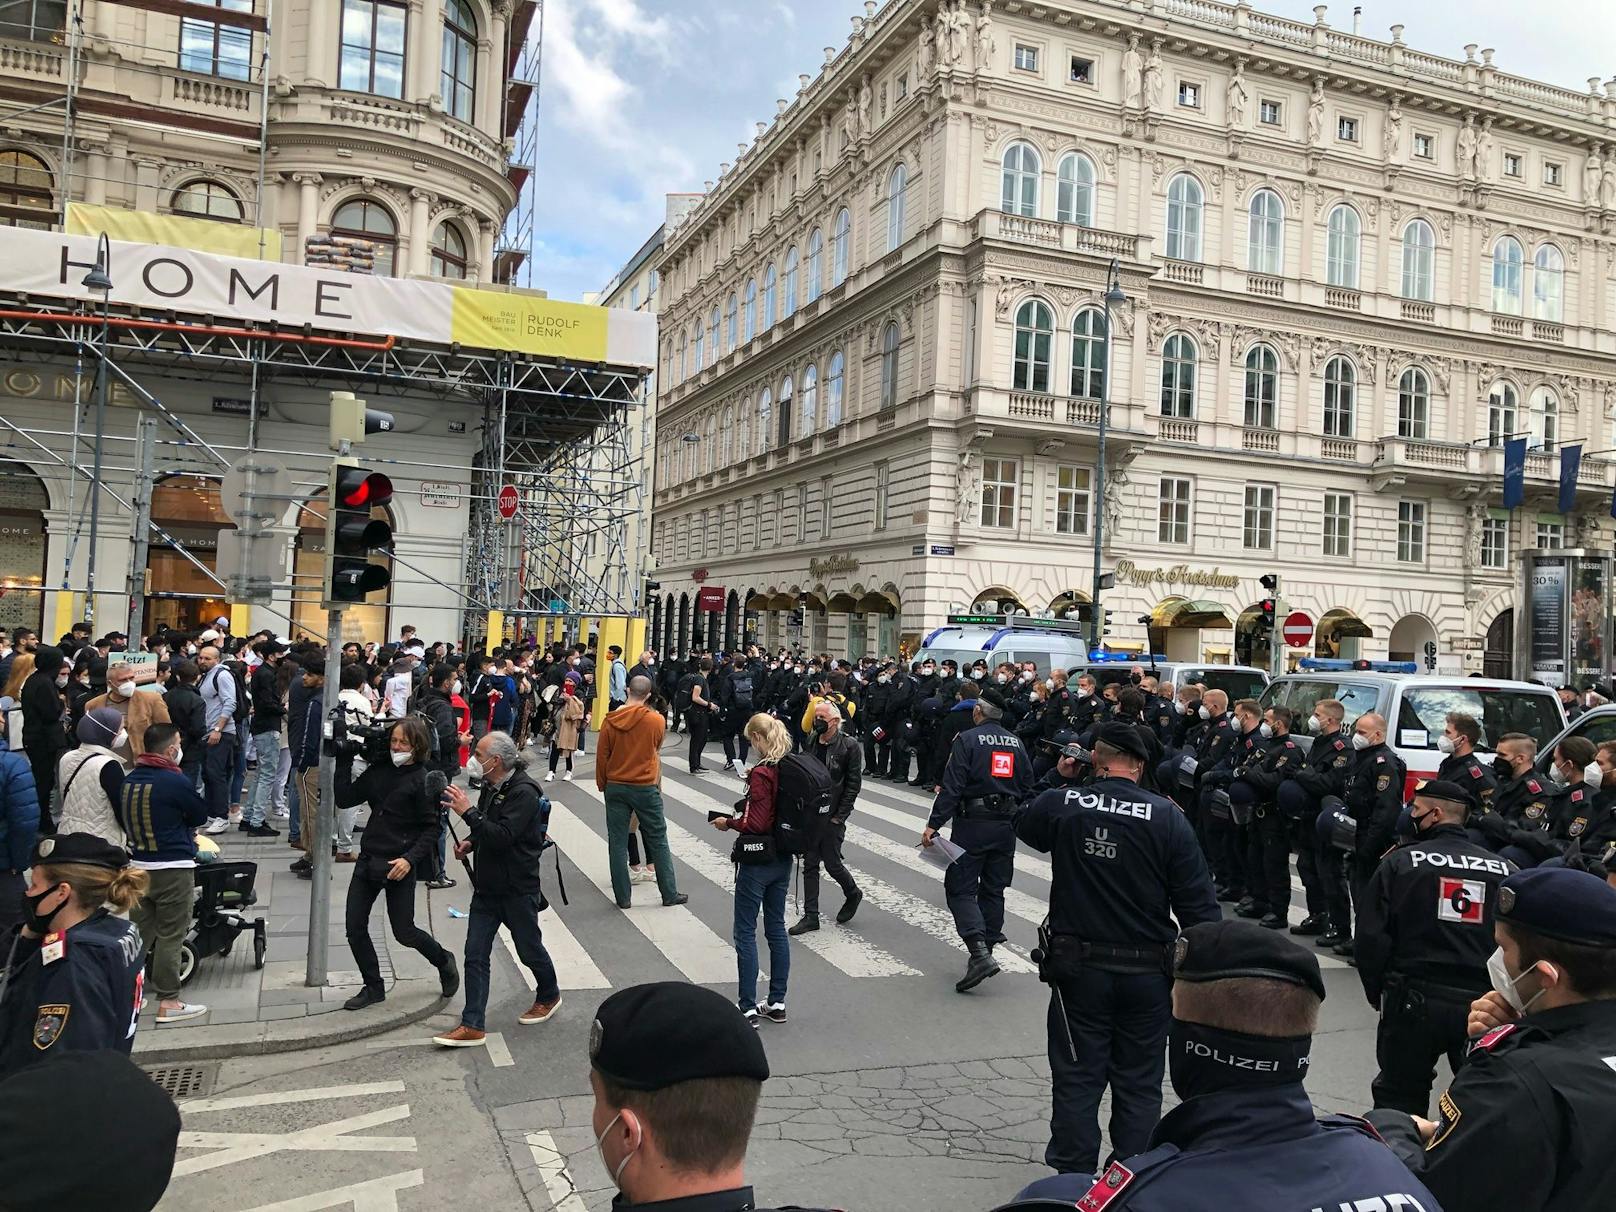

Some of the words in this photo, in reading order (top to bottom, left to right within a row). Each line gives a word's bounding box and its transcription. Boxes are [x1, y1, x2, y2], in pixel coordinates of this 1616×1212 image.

[60, 245, 353, 319] HOME
[482, 314, 516, 325] MEISTER
[527, 314, 580, 329] RUDOLF
[527, 325, 562, 338] DENK
[499, 496, 516, 509] STOP
[1533, 576, 1547, 586] 30
[978, 734, 1020, 749] POLIZEI
[995, 759, 1009, 770] EA
[1064, 789, 1153, 821] POLIZEI
[1095, 826, 1109, 841] U
[743, 842, 764, 852] PRESS
[1083, 841, 1118, 859] 320
[1410, 850, 1510, 876] POLIZEI
[1451, 887, 1472, 914] 6
[1185, 1040, 1280, 1072] POLIZEI
